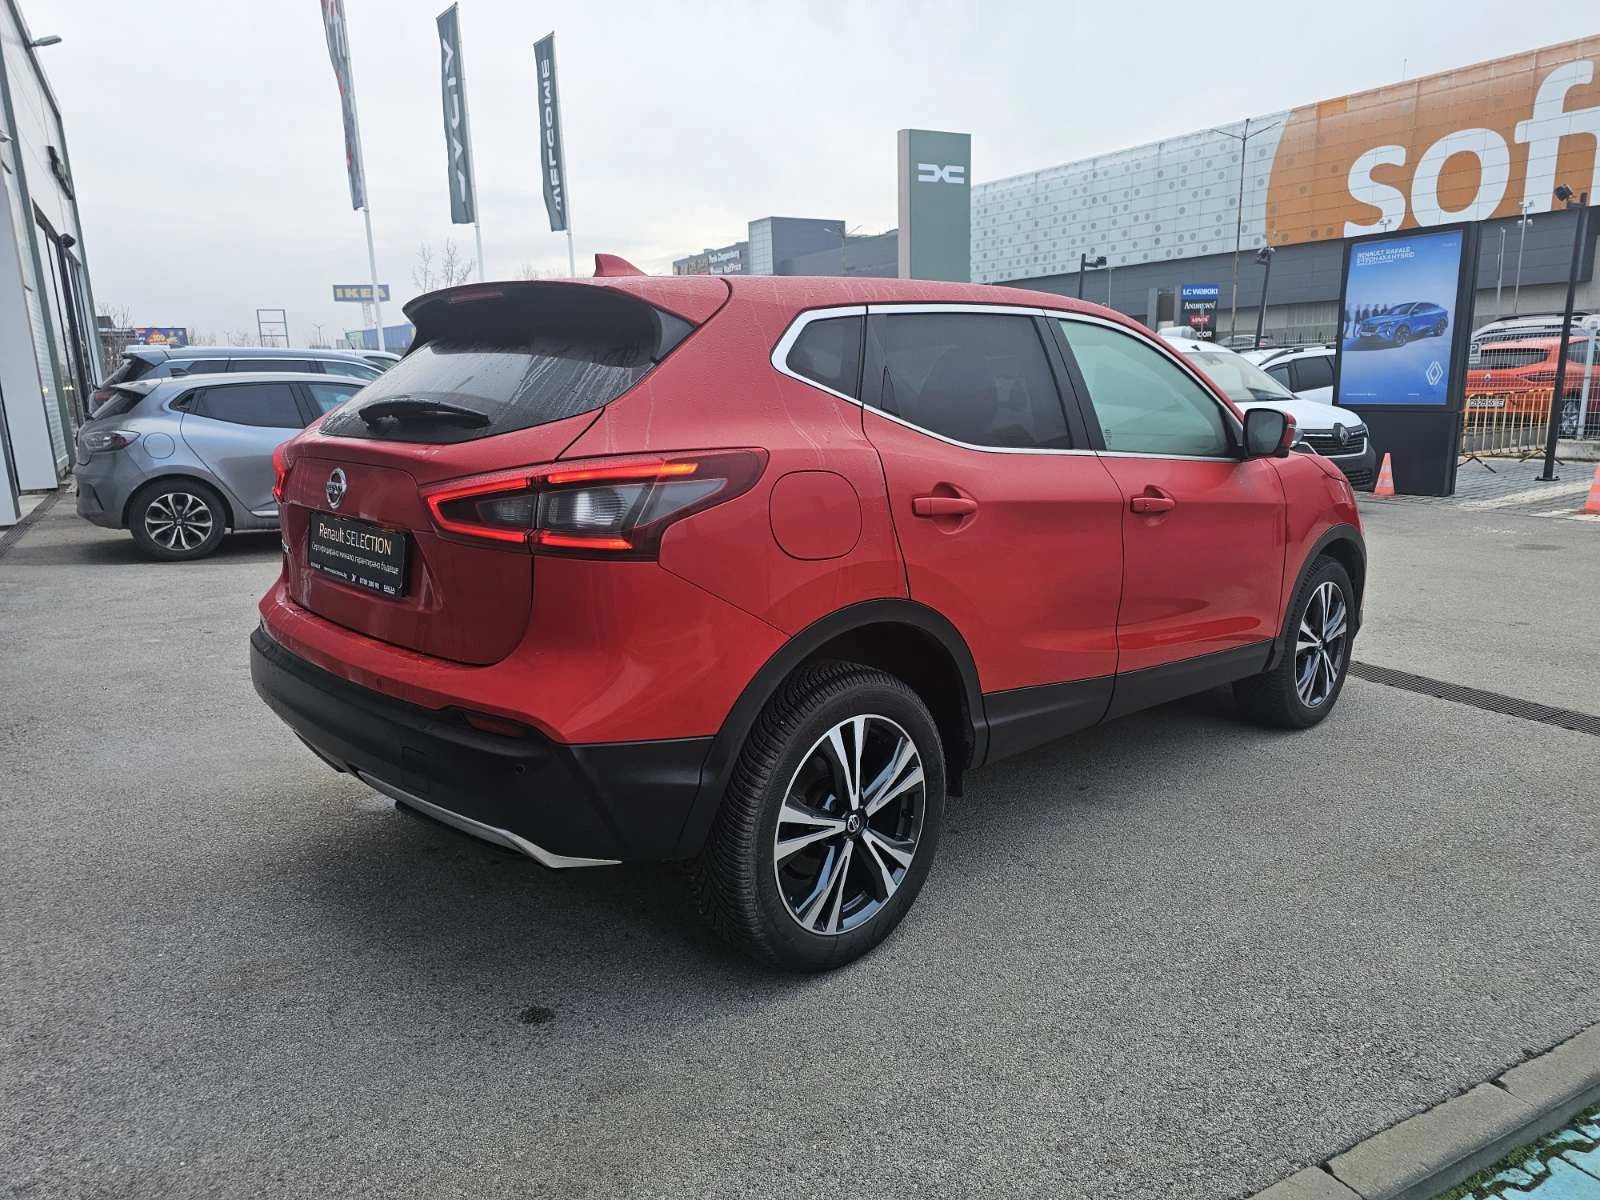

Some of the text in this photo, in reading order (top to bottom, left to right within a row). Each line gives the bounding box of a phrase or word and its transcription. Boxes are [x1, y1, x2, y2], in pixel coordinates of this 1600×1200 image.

[1343, 60, 1600, 238] sof
[335, 287, 386, 298] IKEA
[319, 523, 392, 555] Renault SELECTION
